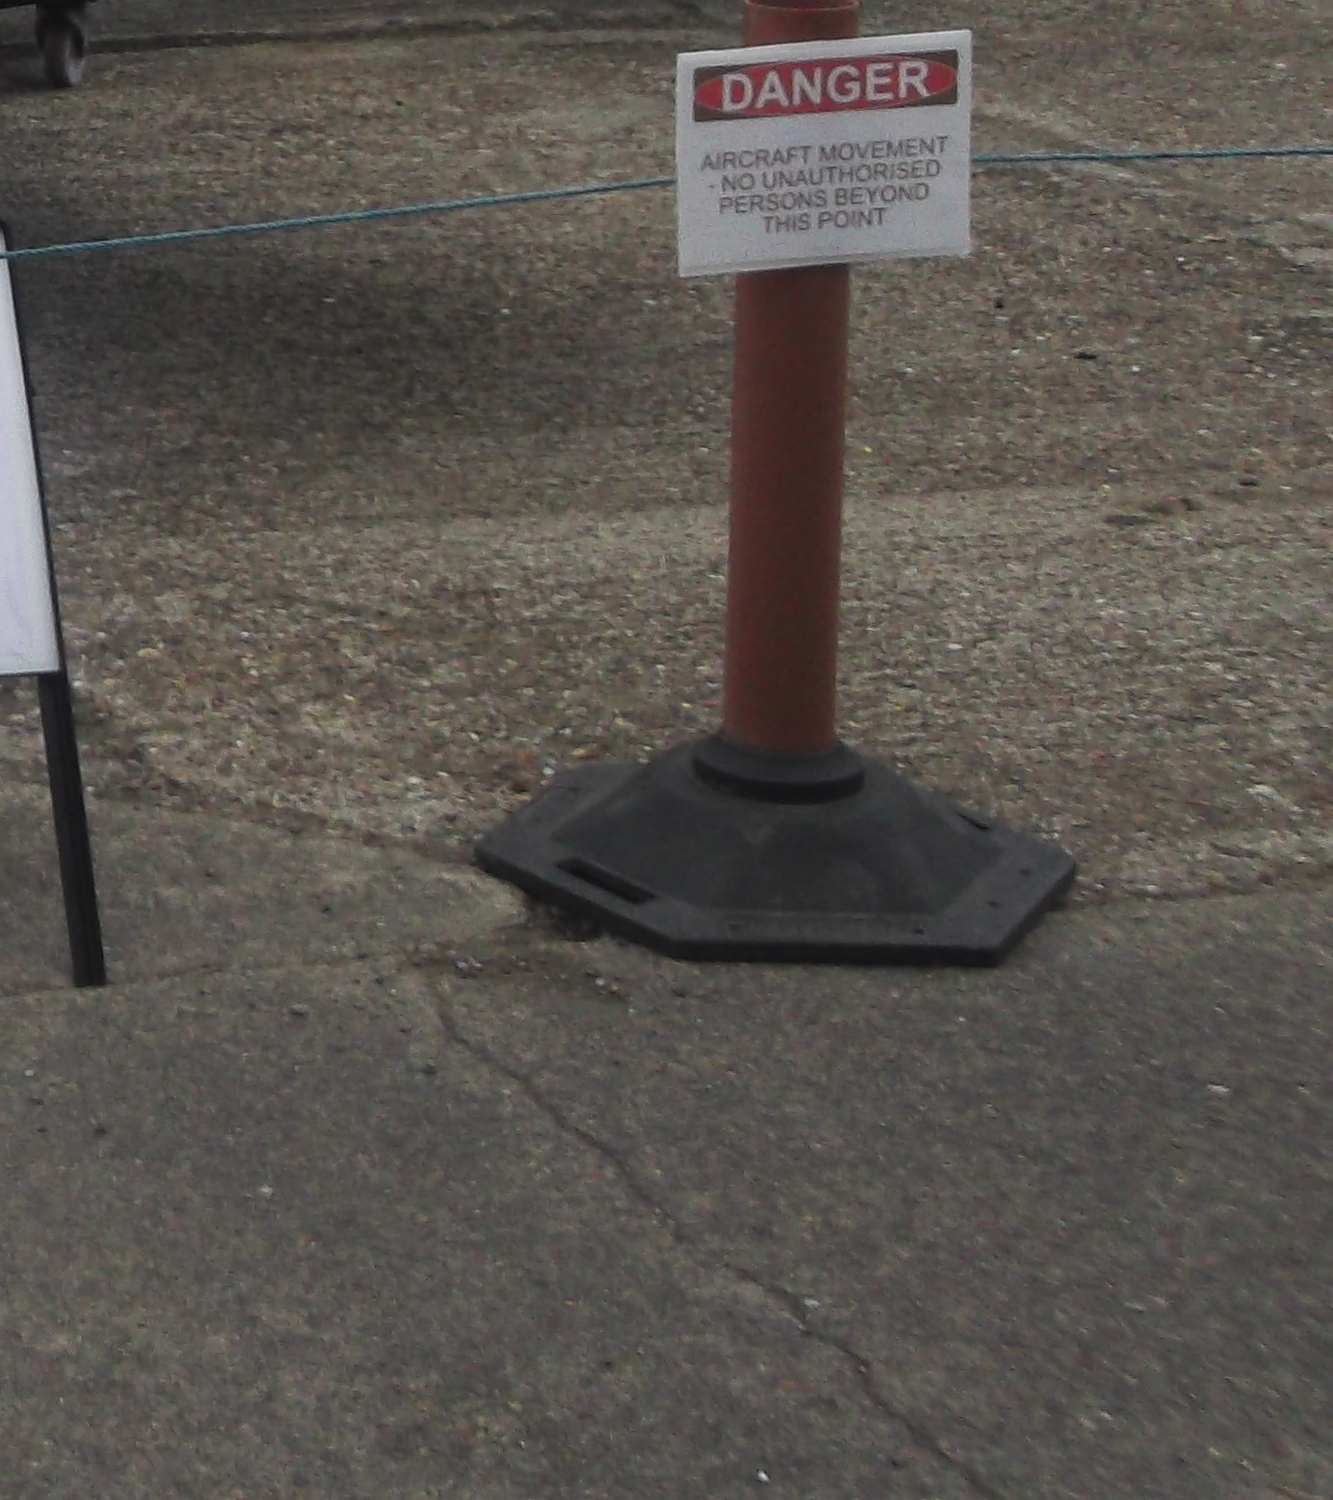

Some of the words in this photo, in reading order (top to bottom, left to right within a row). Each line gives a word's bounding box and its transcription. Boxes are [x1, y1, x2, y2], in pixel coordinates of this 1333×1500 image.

[720, 59, 932, 114] DANGER
[700, 145, 813, 171] AIRCRAFT
[819, 135, 949, 162] MOVEMENT
[721, 172, 755, 192] NO
[762, 159, 941, 189] UNAUTHORISED
[719, 190, 828, 214] PERSONS
[834, 182, 931, 206] BEYOND
[763, 212, 812, 233] THIS
[817, 207, 888, 229] POINT
